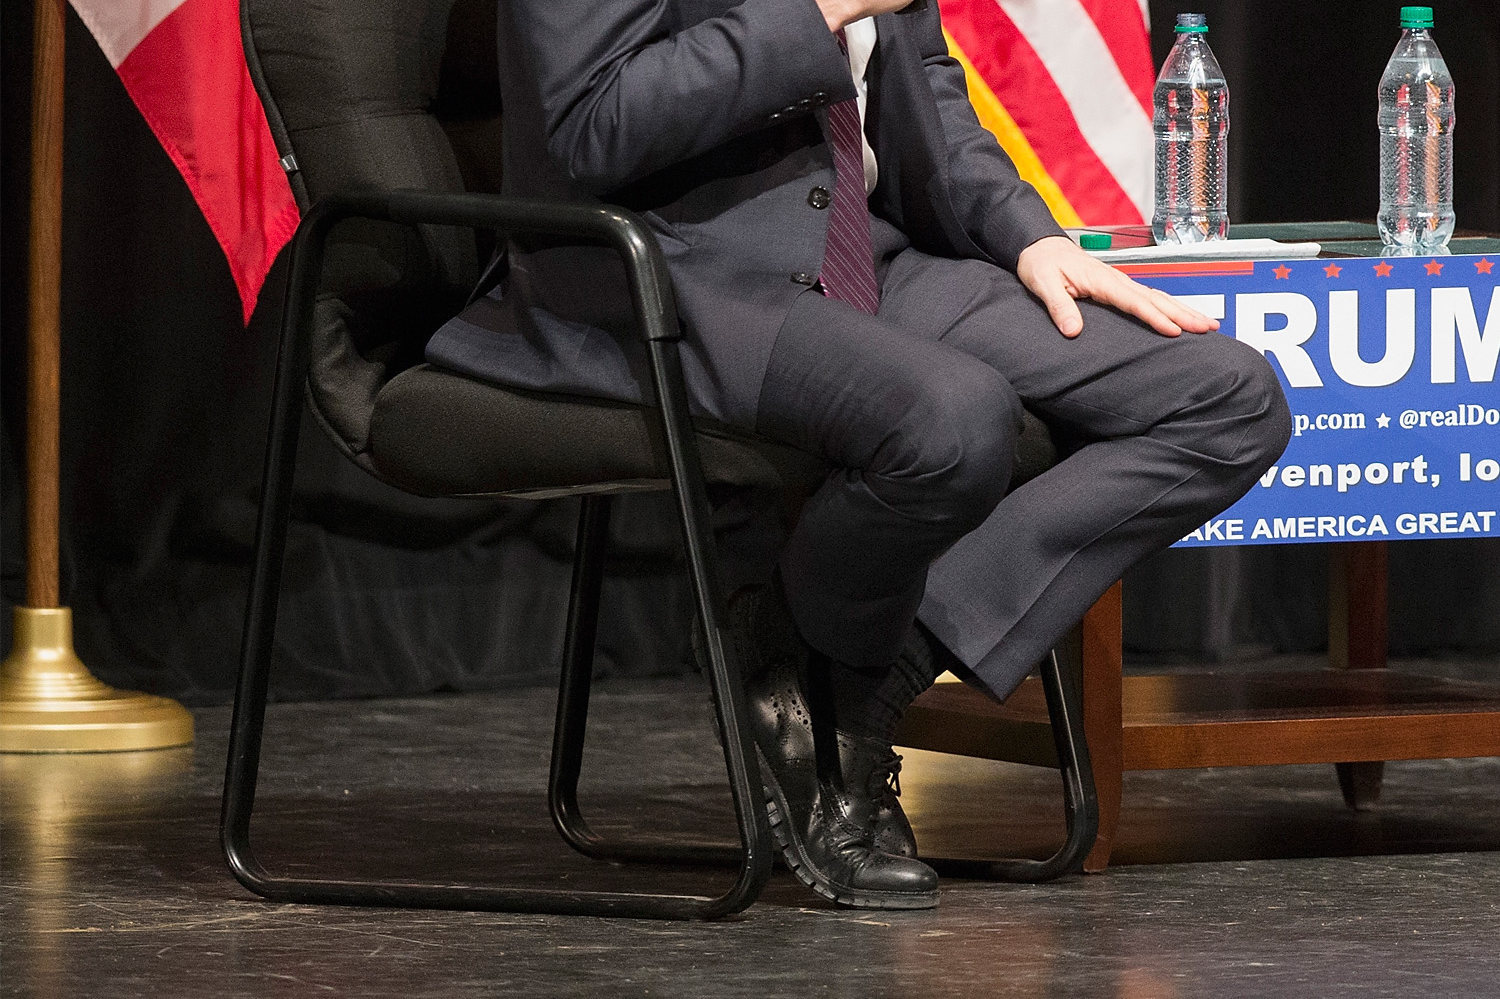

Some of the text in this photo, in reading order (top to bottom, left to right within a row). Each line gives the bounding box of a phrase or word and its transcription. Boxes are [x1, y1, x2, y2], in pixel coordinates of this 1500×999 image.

[1292, 411, 1367, 437] p.com
[1258, 455, 1441, 494] venport,
[1179, 519, 1245, 542] AKE
[1250, 514, 1390, 540] AMERICA
[1395, 510, 1497, 535] GREAT
